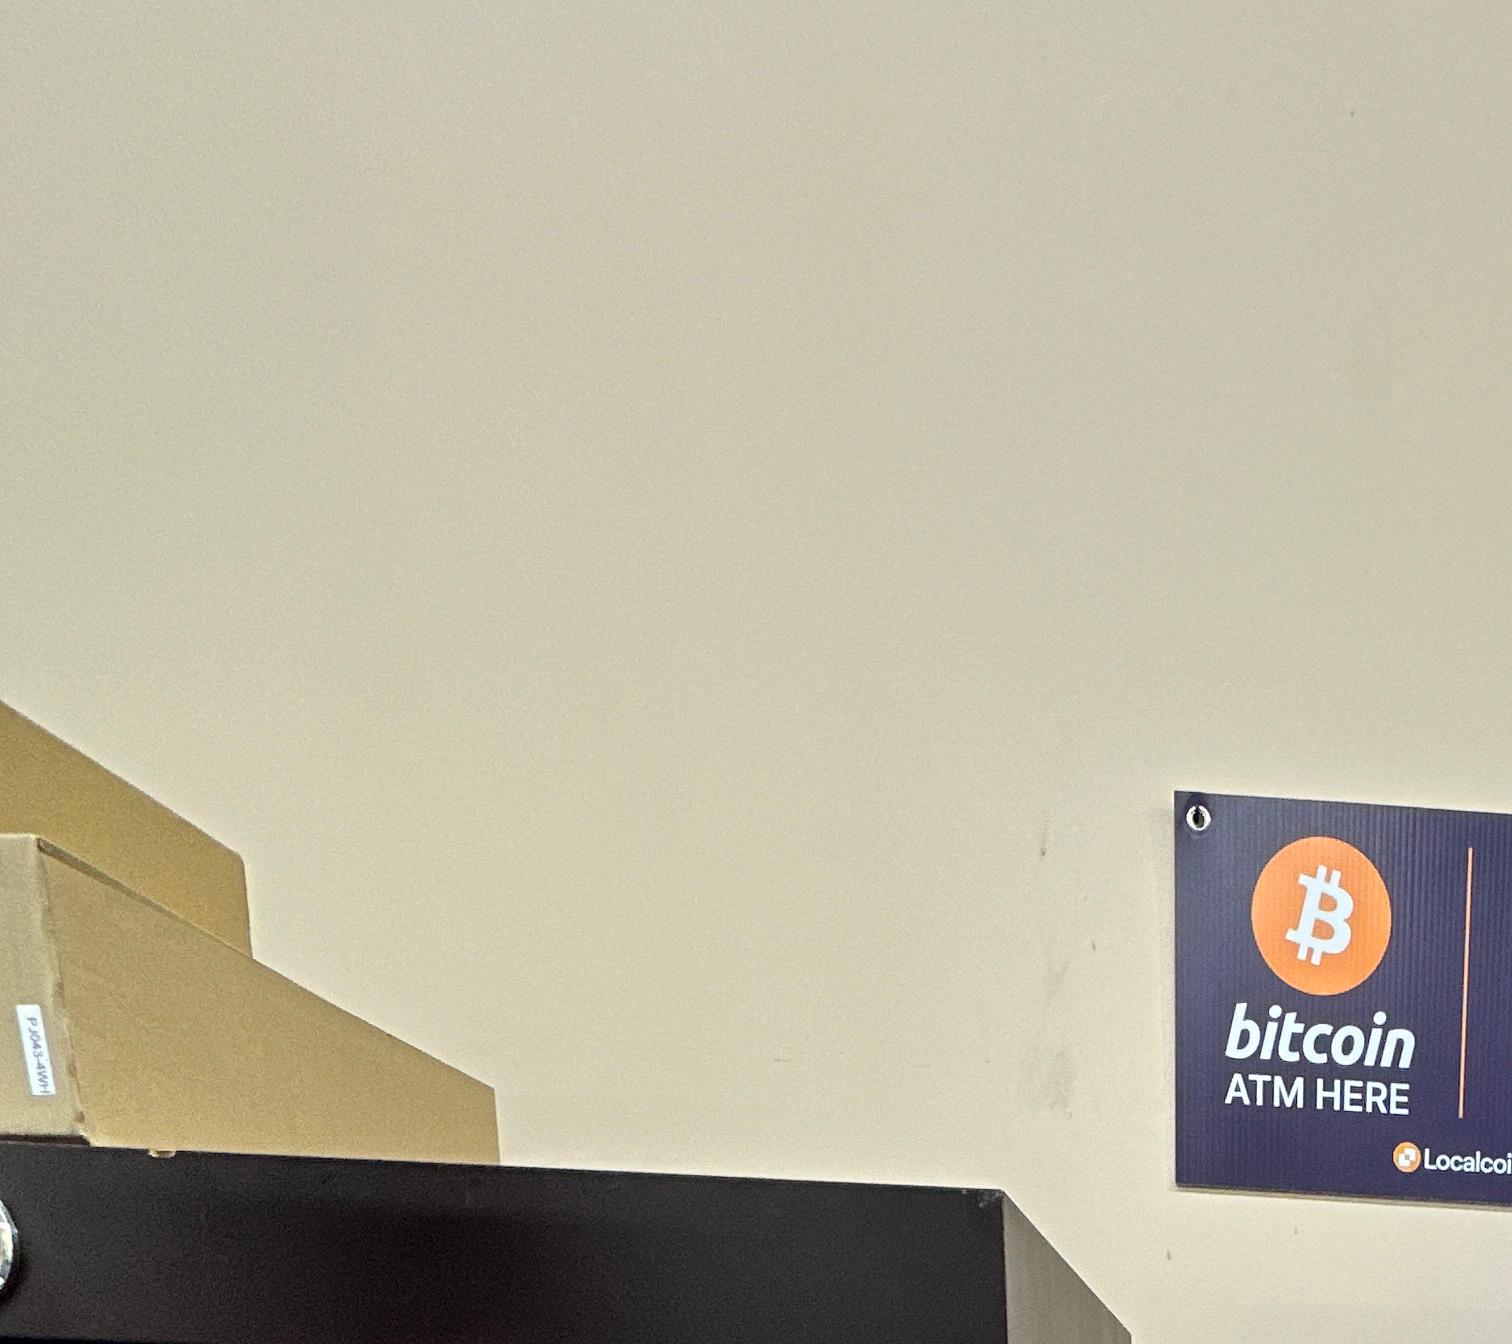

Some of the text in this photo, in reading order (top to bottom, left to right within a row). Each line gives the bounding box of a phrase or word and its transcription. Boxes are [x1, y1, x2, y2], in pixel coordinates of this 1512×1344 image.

[1225, 1002, 1416, 1069] bitcoin
[1225, 1073, 1410, 1116] ATM HERE
